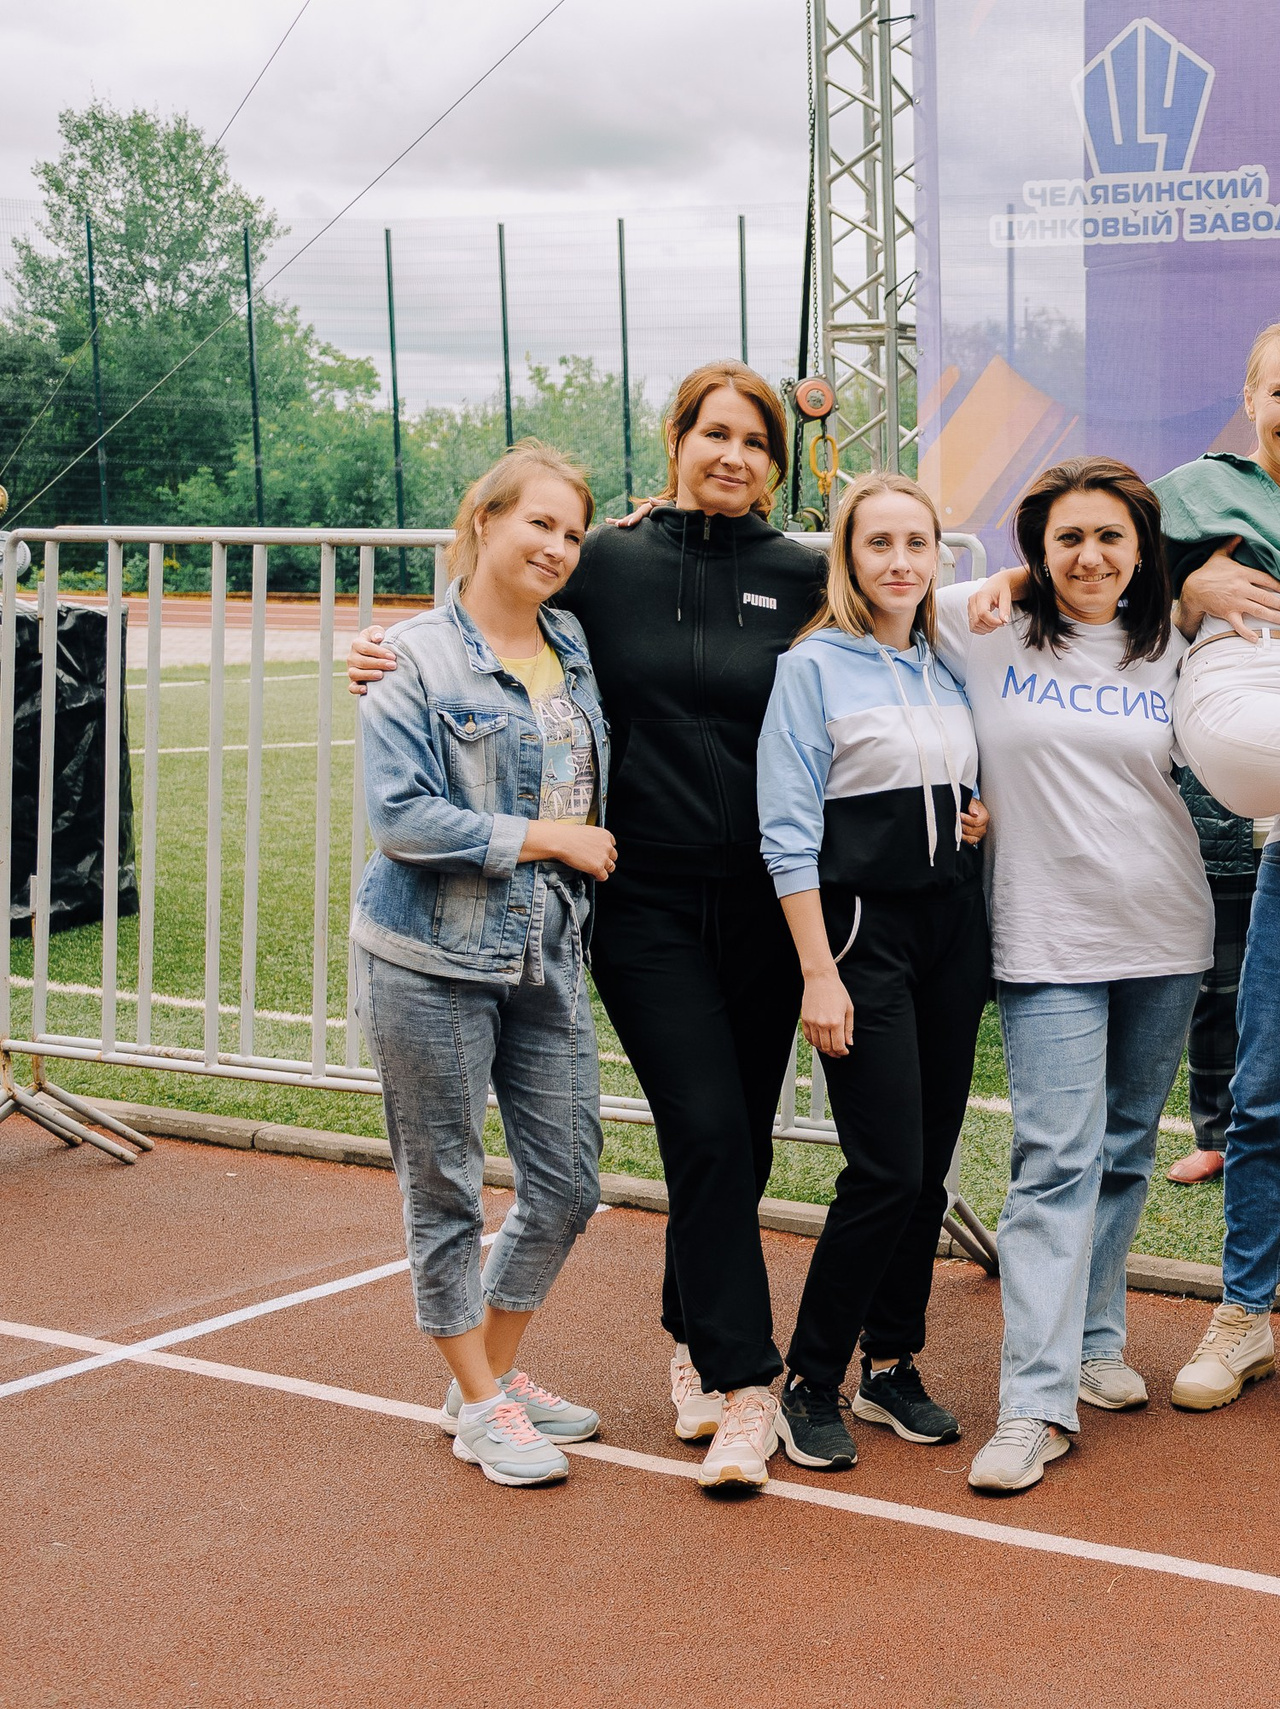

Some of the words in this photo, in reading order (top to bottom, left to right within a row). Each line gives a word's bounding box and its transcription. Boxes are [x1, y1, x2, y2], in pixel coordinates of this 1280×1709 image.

[1027, 171, 1263, 207] ЧЕЛЯБИНСКИЙ
[994, 209, 1173, 240] ЦИНКОВЫЙ
[742, 592, 777, 610] PUMA
[1001, 665, 1170, 724] МАССИВ
